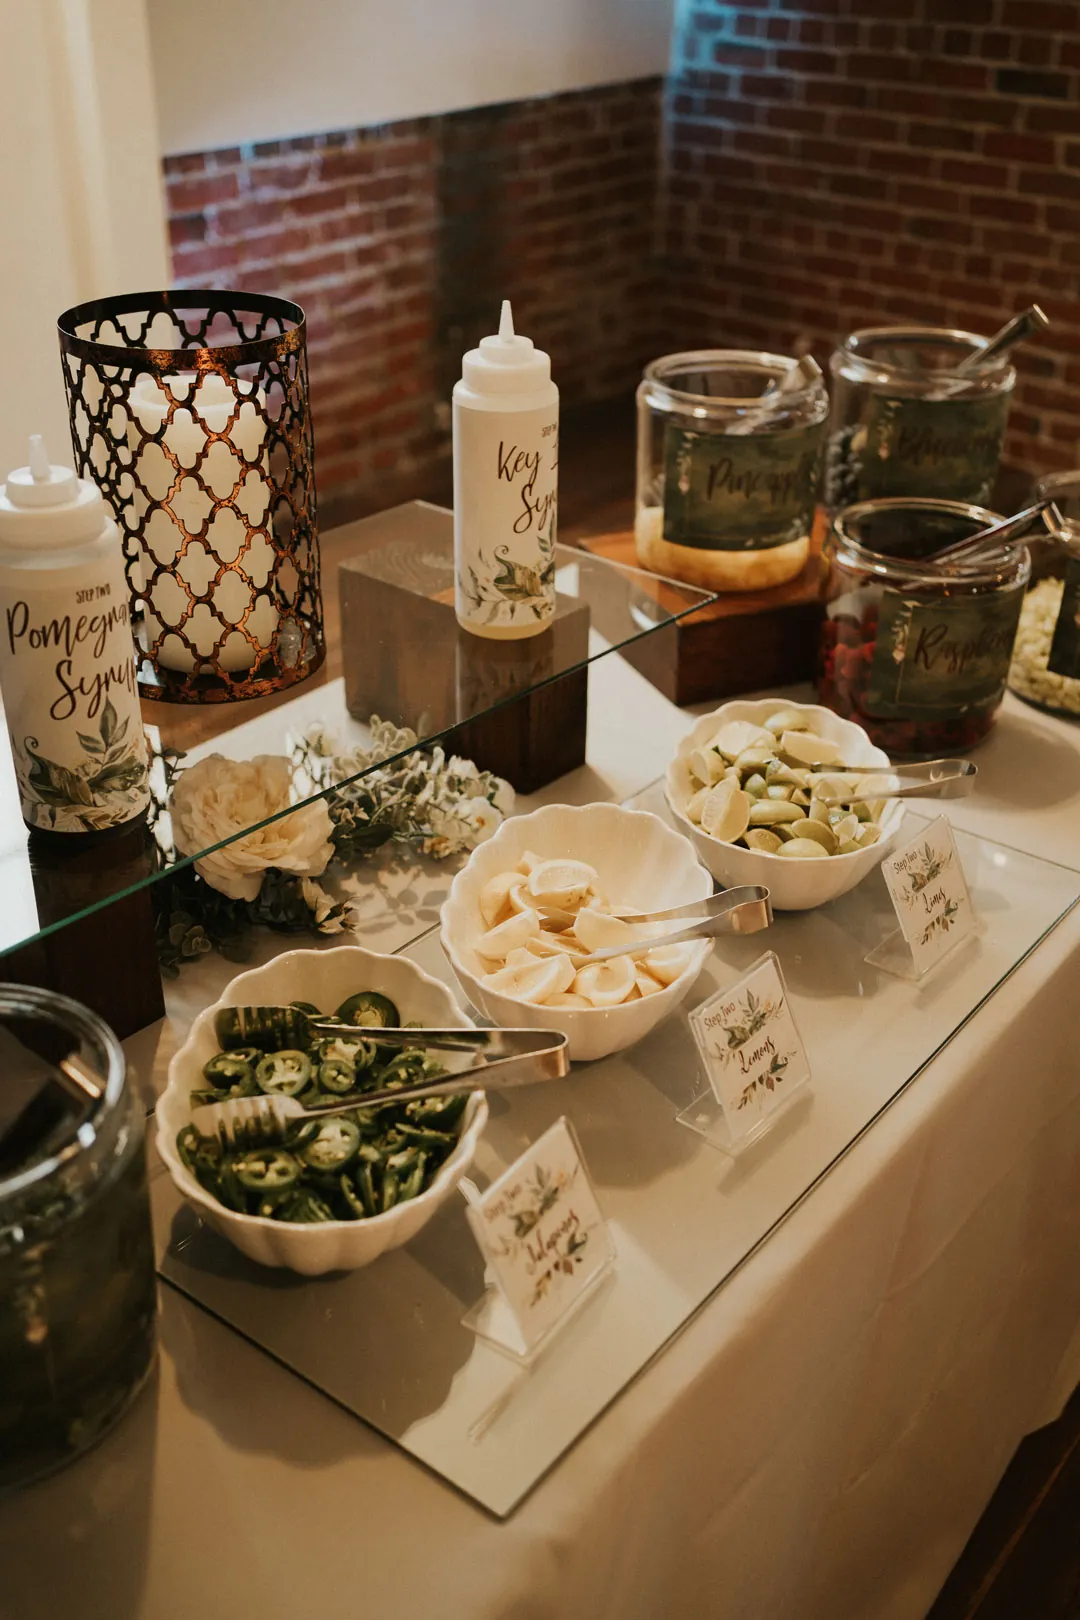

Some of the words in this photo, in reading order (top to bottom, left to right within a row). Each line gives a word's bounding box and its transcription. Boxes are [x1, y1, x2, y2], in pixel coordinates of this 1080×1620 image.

[497, 440, 541, 487] Key
[513, 483, 557, 534] Syr
[76, 588, 95, 605] STEP
[95, 583, 111, 600] TWO
[6, 600, 131, 660] Pomegra
[893, 859, 908, 875] Step
[905, 850, 917, 865] Two
[922, 886, 947, 914] Limes
[703, 1011, 723, 1032] Step
[720, 1001, 737, 1018] Two
[738, 1035, 776, 1075] Lemons
